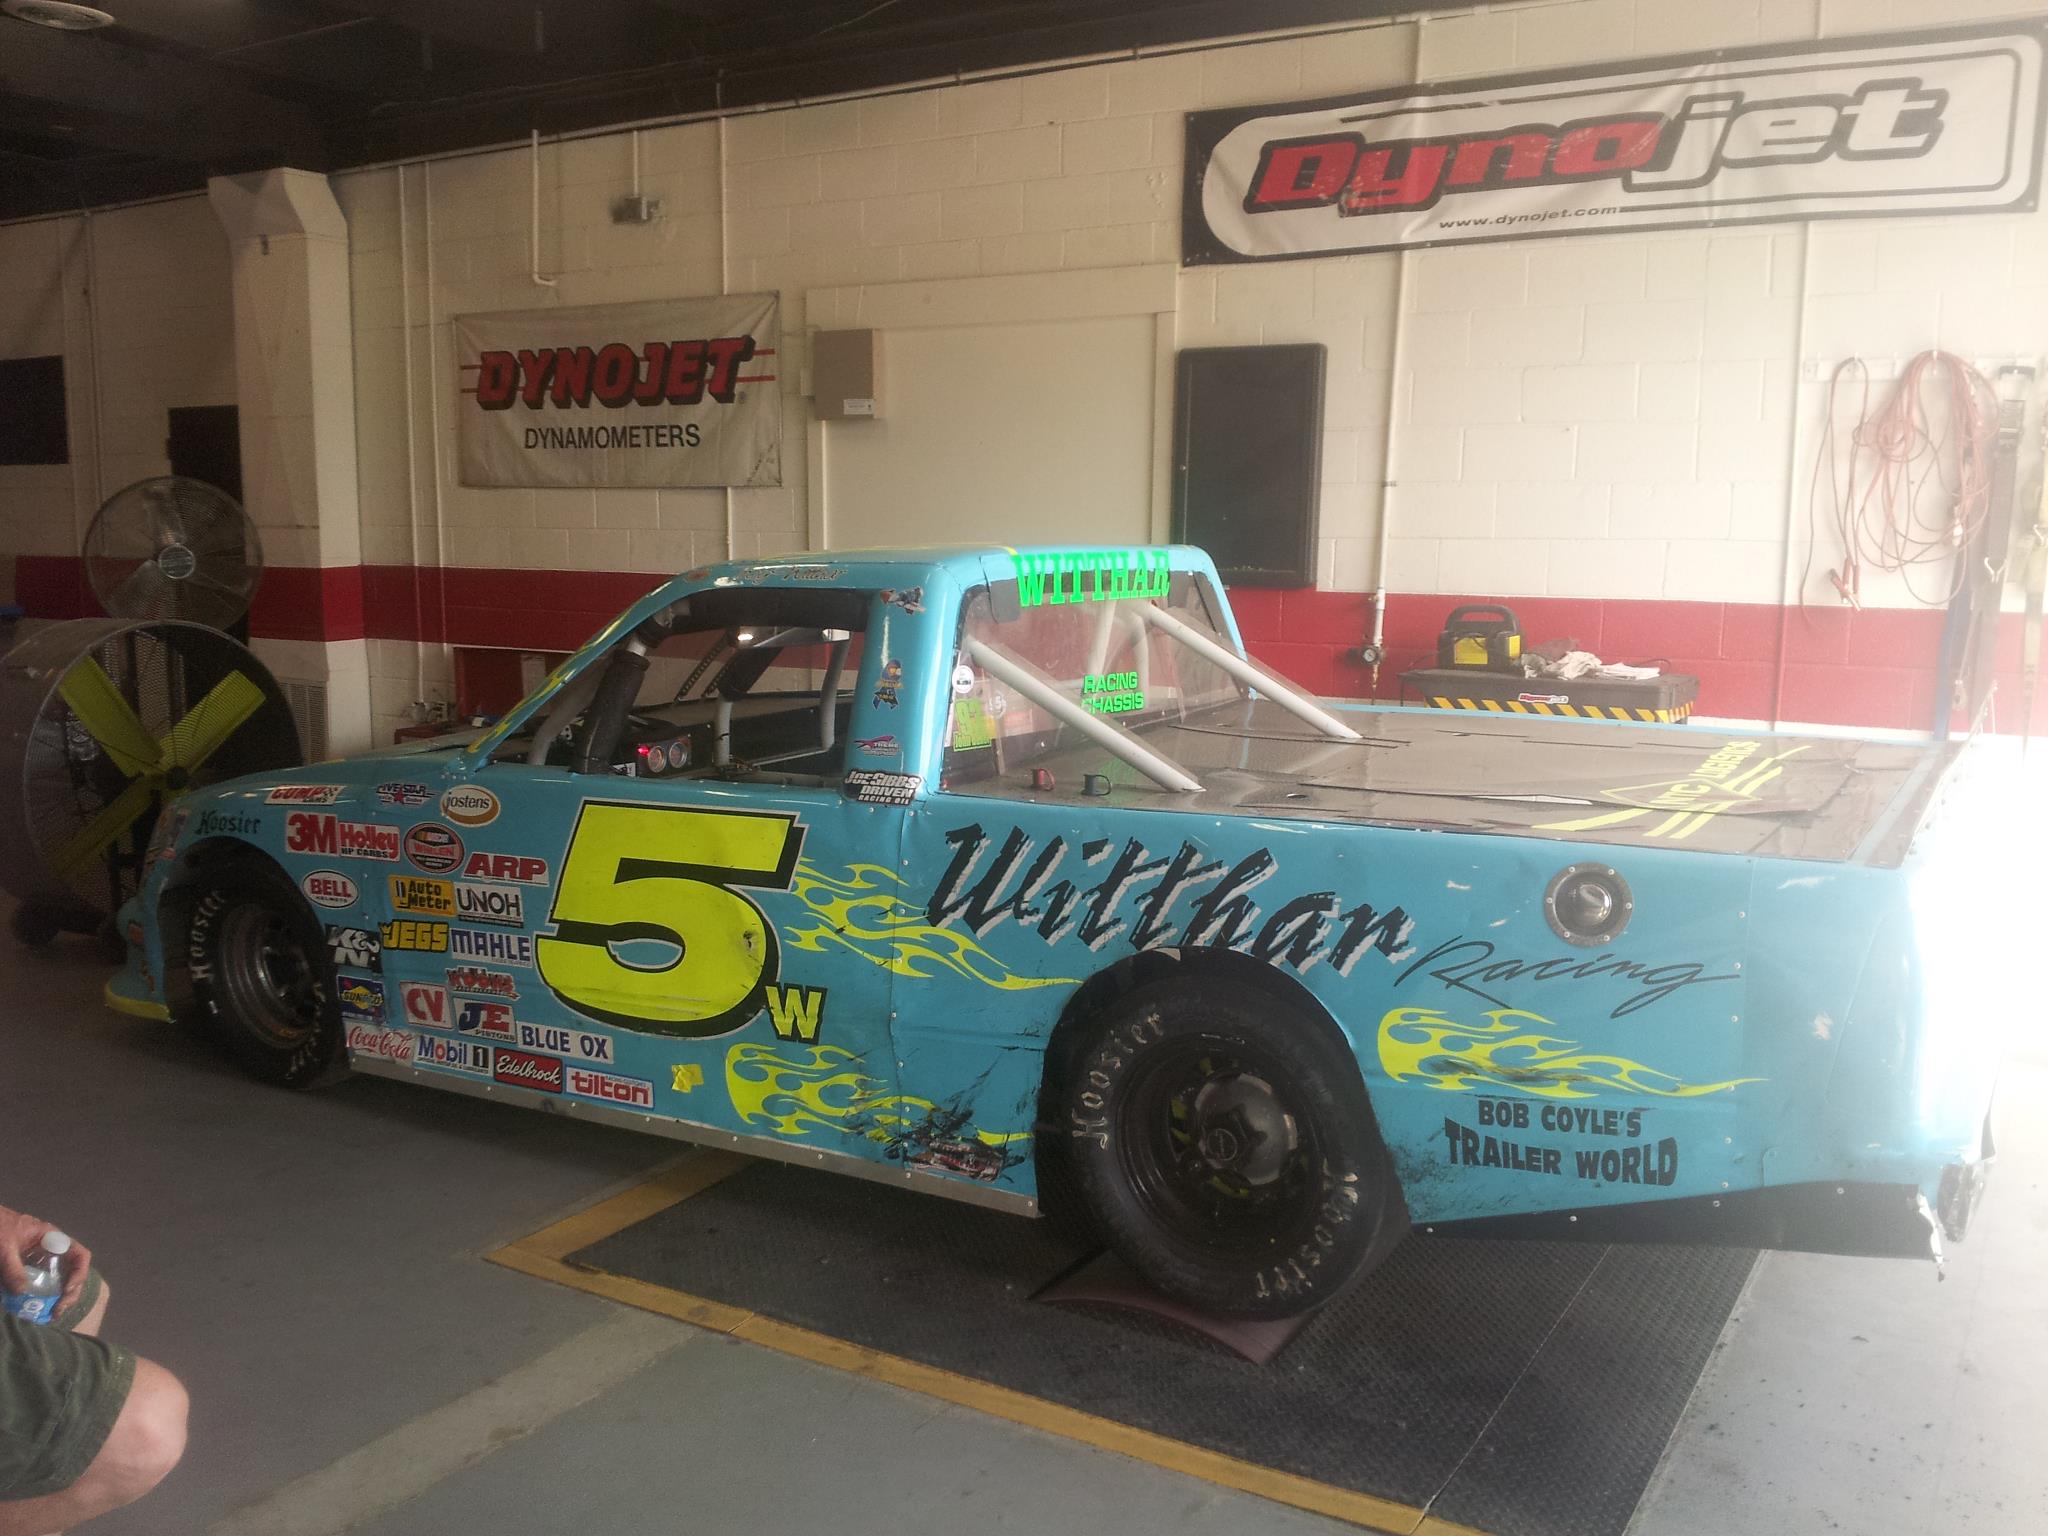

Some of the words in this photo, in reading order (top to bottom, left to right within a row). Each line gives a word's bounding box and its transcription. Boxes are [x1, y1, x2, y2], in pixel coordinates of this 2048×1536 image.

[1243, 77, 1949, 217] Dynojet
[1439, 206, 1617, 229] www.dynojet.com
[476, 334, 756, 411] DYNOJET
[525, 424, 700, 449] DYNAMOMETERS
[1011, 551, 1170, 607] WITTHAR
[1084, 671, 1138, 694] RACING
[1081, 691, 1145, 714] CHASSIS
[447, 791, 490, 810] jostens
[858, 795, 891, 803] RACING
[894, 797, 910, 805] OIL
[859, 785, 915, 798] DRIVEN
[195, 810, 261, 835] Hoosier
[287, 813, 337, 854] 3M
[339, 822, 398, 859] Holley
[341, 847, 354, 855] HP
[356, 848, 388, 858] CARBS
[464, 853, 546, 880] ARP
[310, 878, 352, 897] BELL
[407, 893, 450, 910] Meter
[408, 880, 441, 896] Auto
[456, 888, 521, 917] UNOH
[924, 822, 1417, 978] Witthar
[534, 797, 809, 1041] 5
[382, 922, 449, 952] JEGS
[451, 929, 531, 961] MAHLE
[1394, 935, 1741, 1019] Racing
[406, 988, 443, 1022] CV
[459, 1002, 509, 1032] JE
[764, 982, 827, 1045] W
[348, 1025, 413, 1060] Coca-Cola
[418, 1035, 468, 1065] Mobil
[475, 1029, 515, 1042] PISTONS
[522, 1025, 571, 1053] BLUE
[580, 1036, 609, 1060] OX
[496, 1055, 561, 1084] Edelbrock
[571, 1070, 649, 1105] tilton
[1479, 1100, 1529, 1129] BOB
[1541, 1105, 1642, 1137] COYLE'S
[1444, 1117, 1562, 1176] TRAILER
[1576, 1136, 1678, 1187] WORLD
